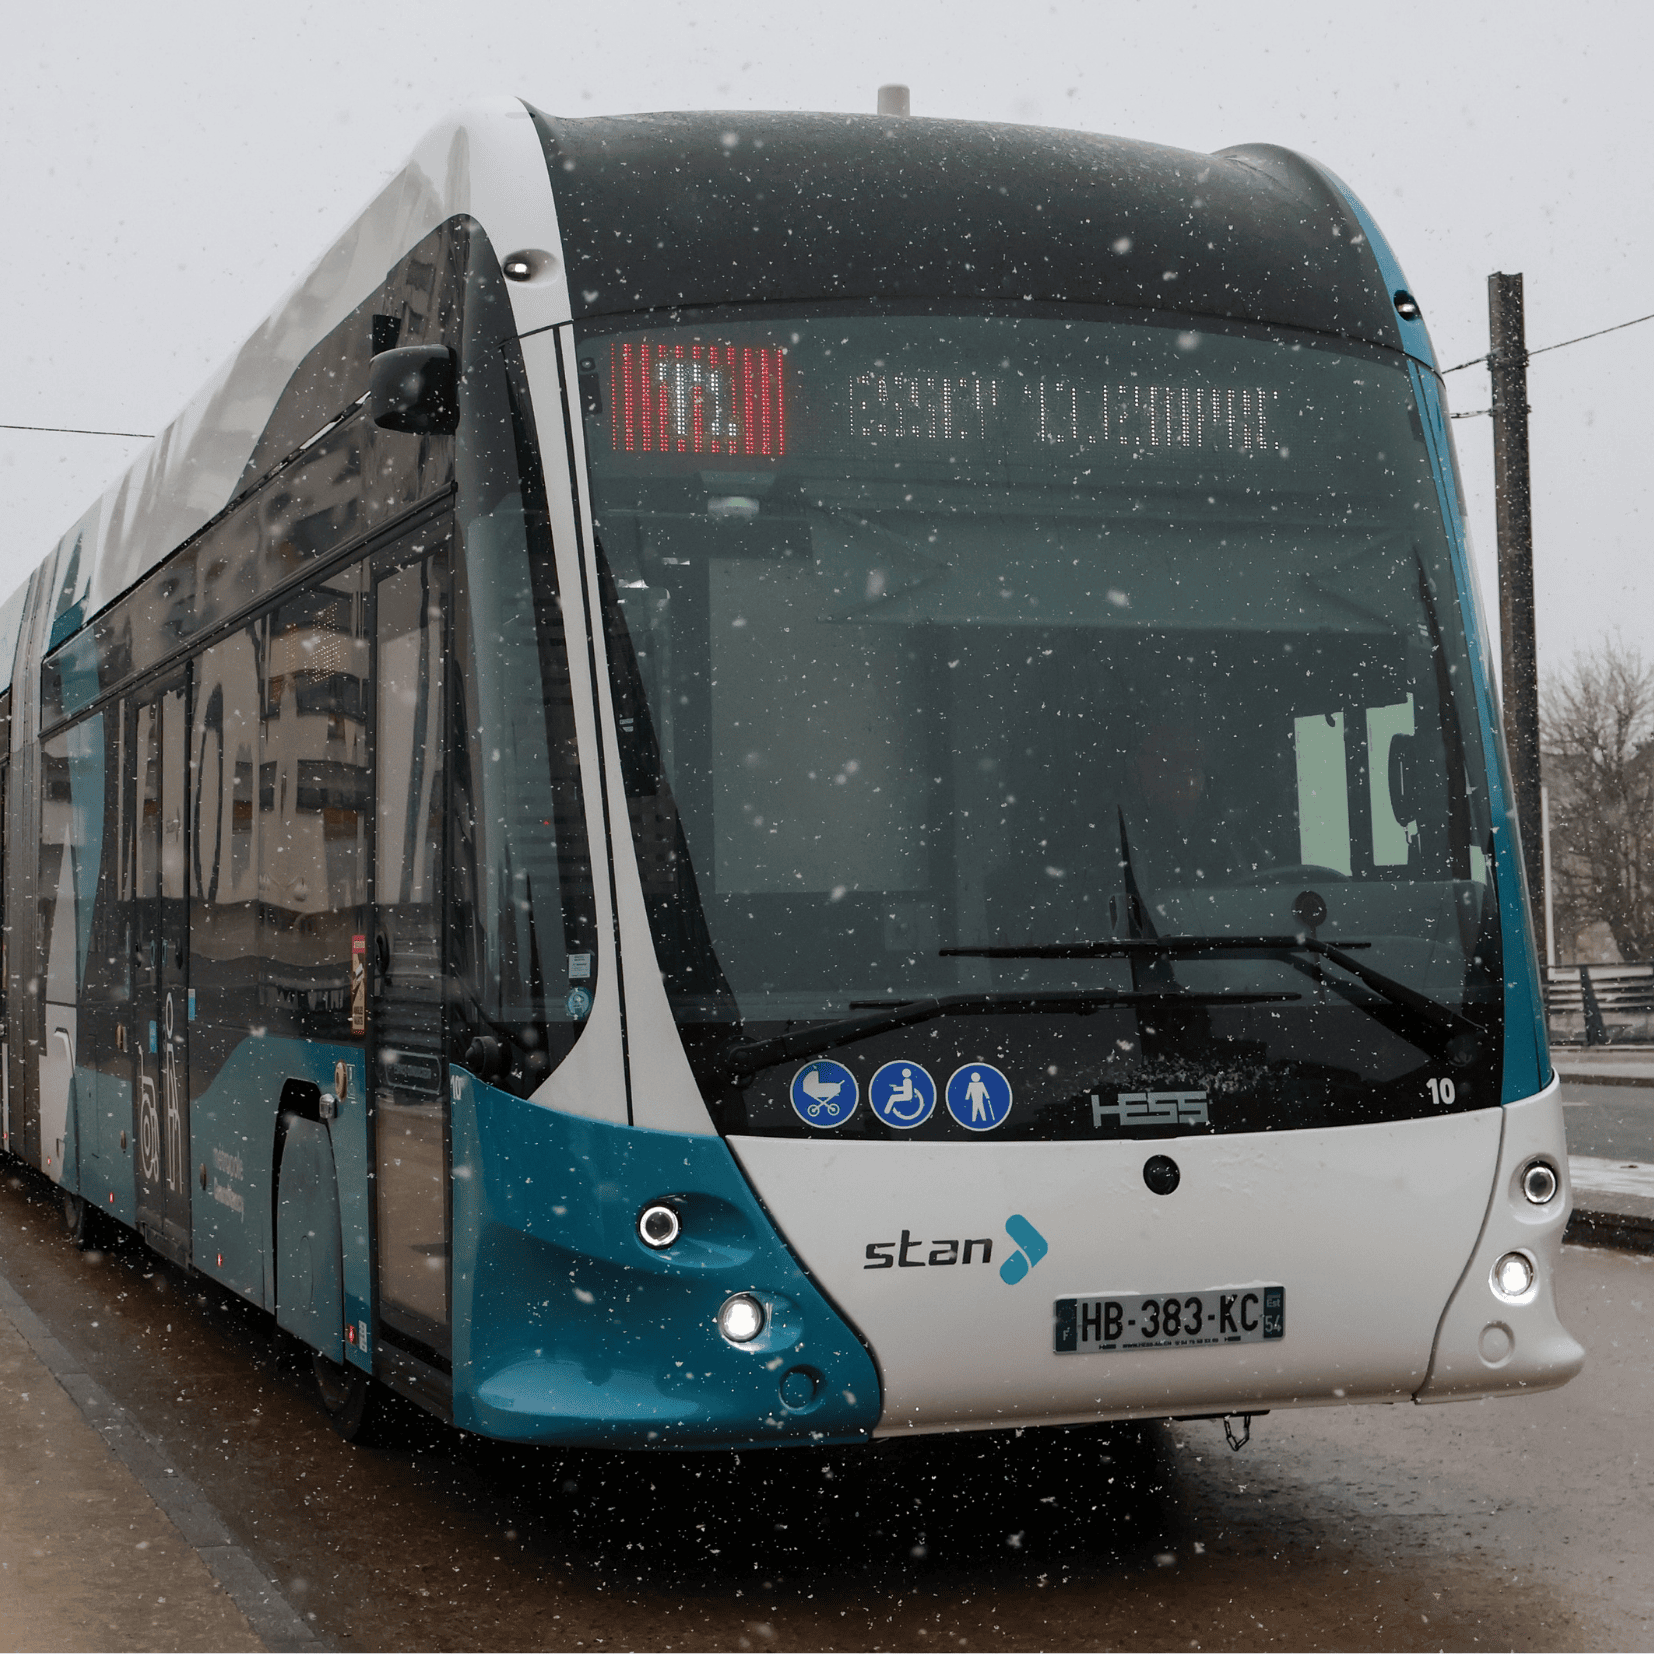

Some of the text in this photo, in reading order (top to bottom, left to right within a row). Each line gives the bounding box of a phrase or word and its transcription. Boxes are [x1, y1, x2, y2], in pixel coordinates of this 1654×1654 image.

[1426, 1077, 1456, 1105] 10
[1091, 1091, 1209, 1127] HESS
[863, 1229, 993, 1270] stan
[1081, 1293, 1259, 1342] HB-383-KC
[1265, 1314, 1282, 1333] 54
[1062, 1329, 1070, 1342] F
